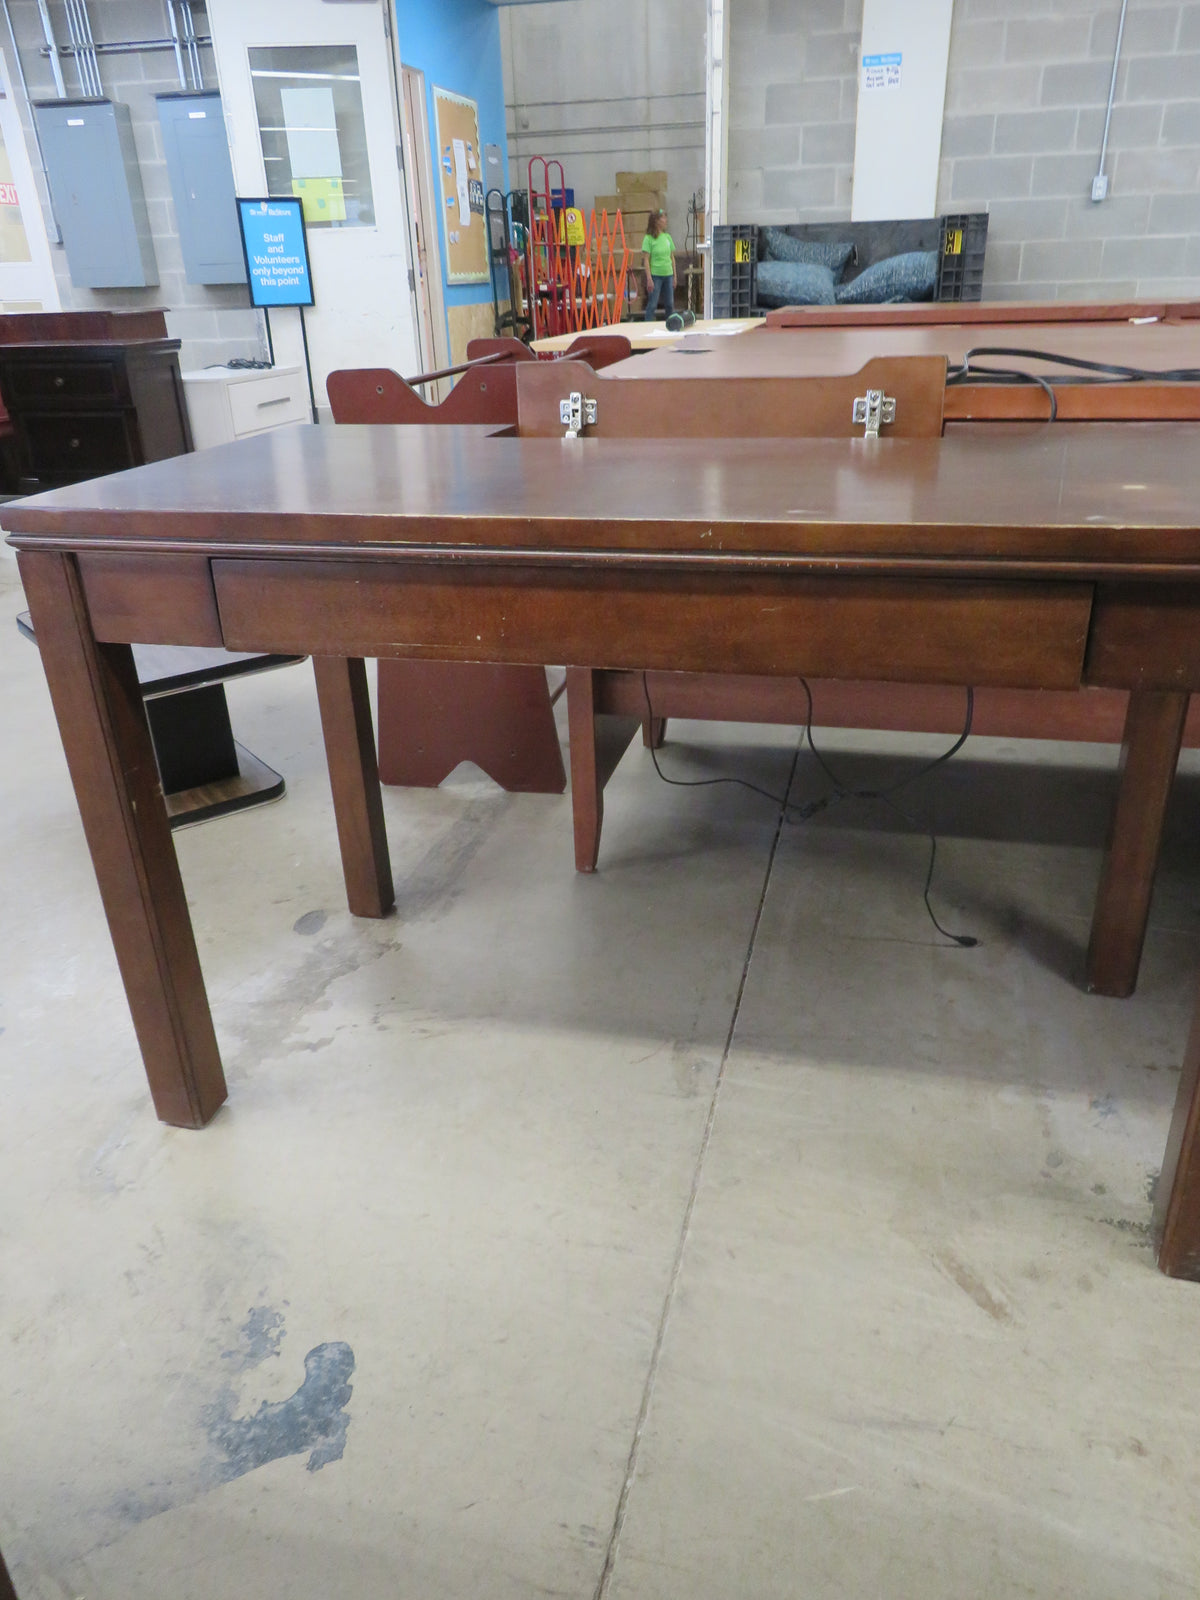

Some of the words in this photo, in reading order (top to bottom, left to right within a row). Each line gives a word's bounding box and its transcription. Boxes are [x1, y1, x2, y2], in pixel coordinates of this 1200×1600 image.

[264, 233, 284, 242] Staff
[268, 244, 283, 253] and
[254, 256, 300, 264] Volunteers
[253, 267, 271, 277] only
[273, 265, 304, 275] beyond
[261, 277, 276, 286] this
[277, 277, 299, 286] point
